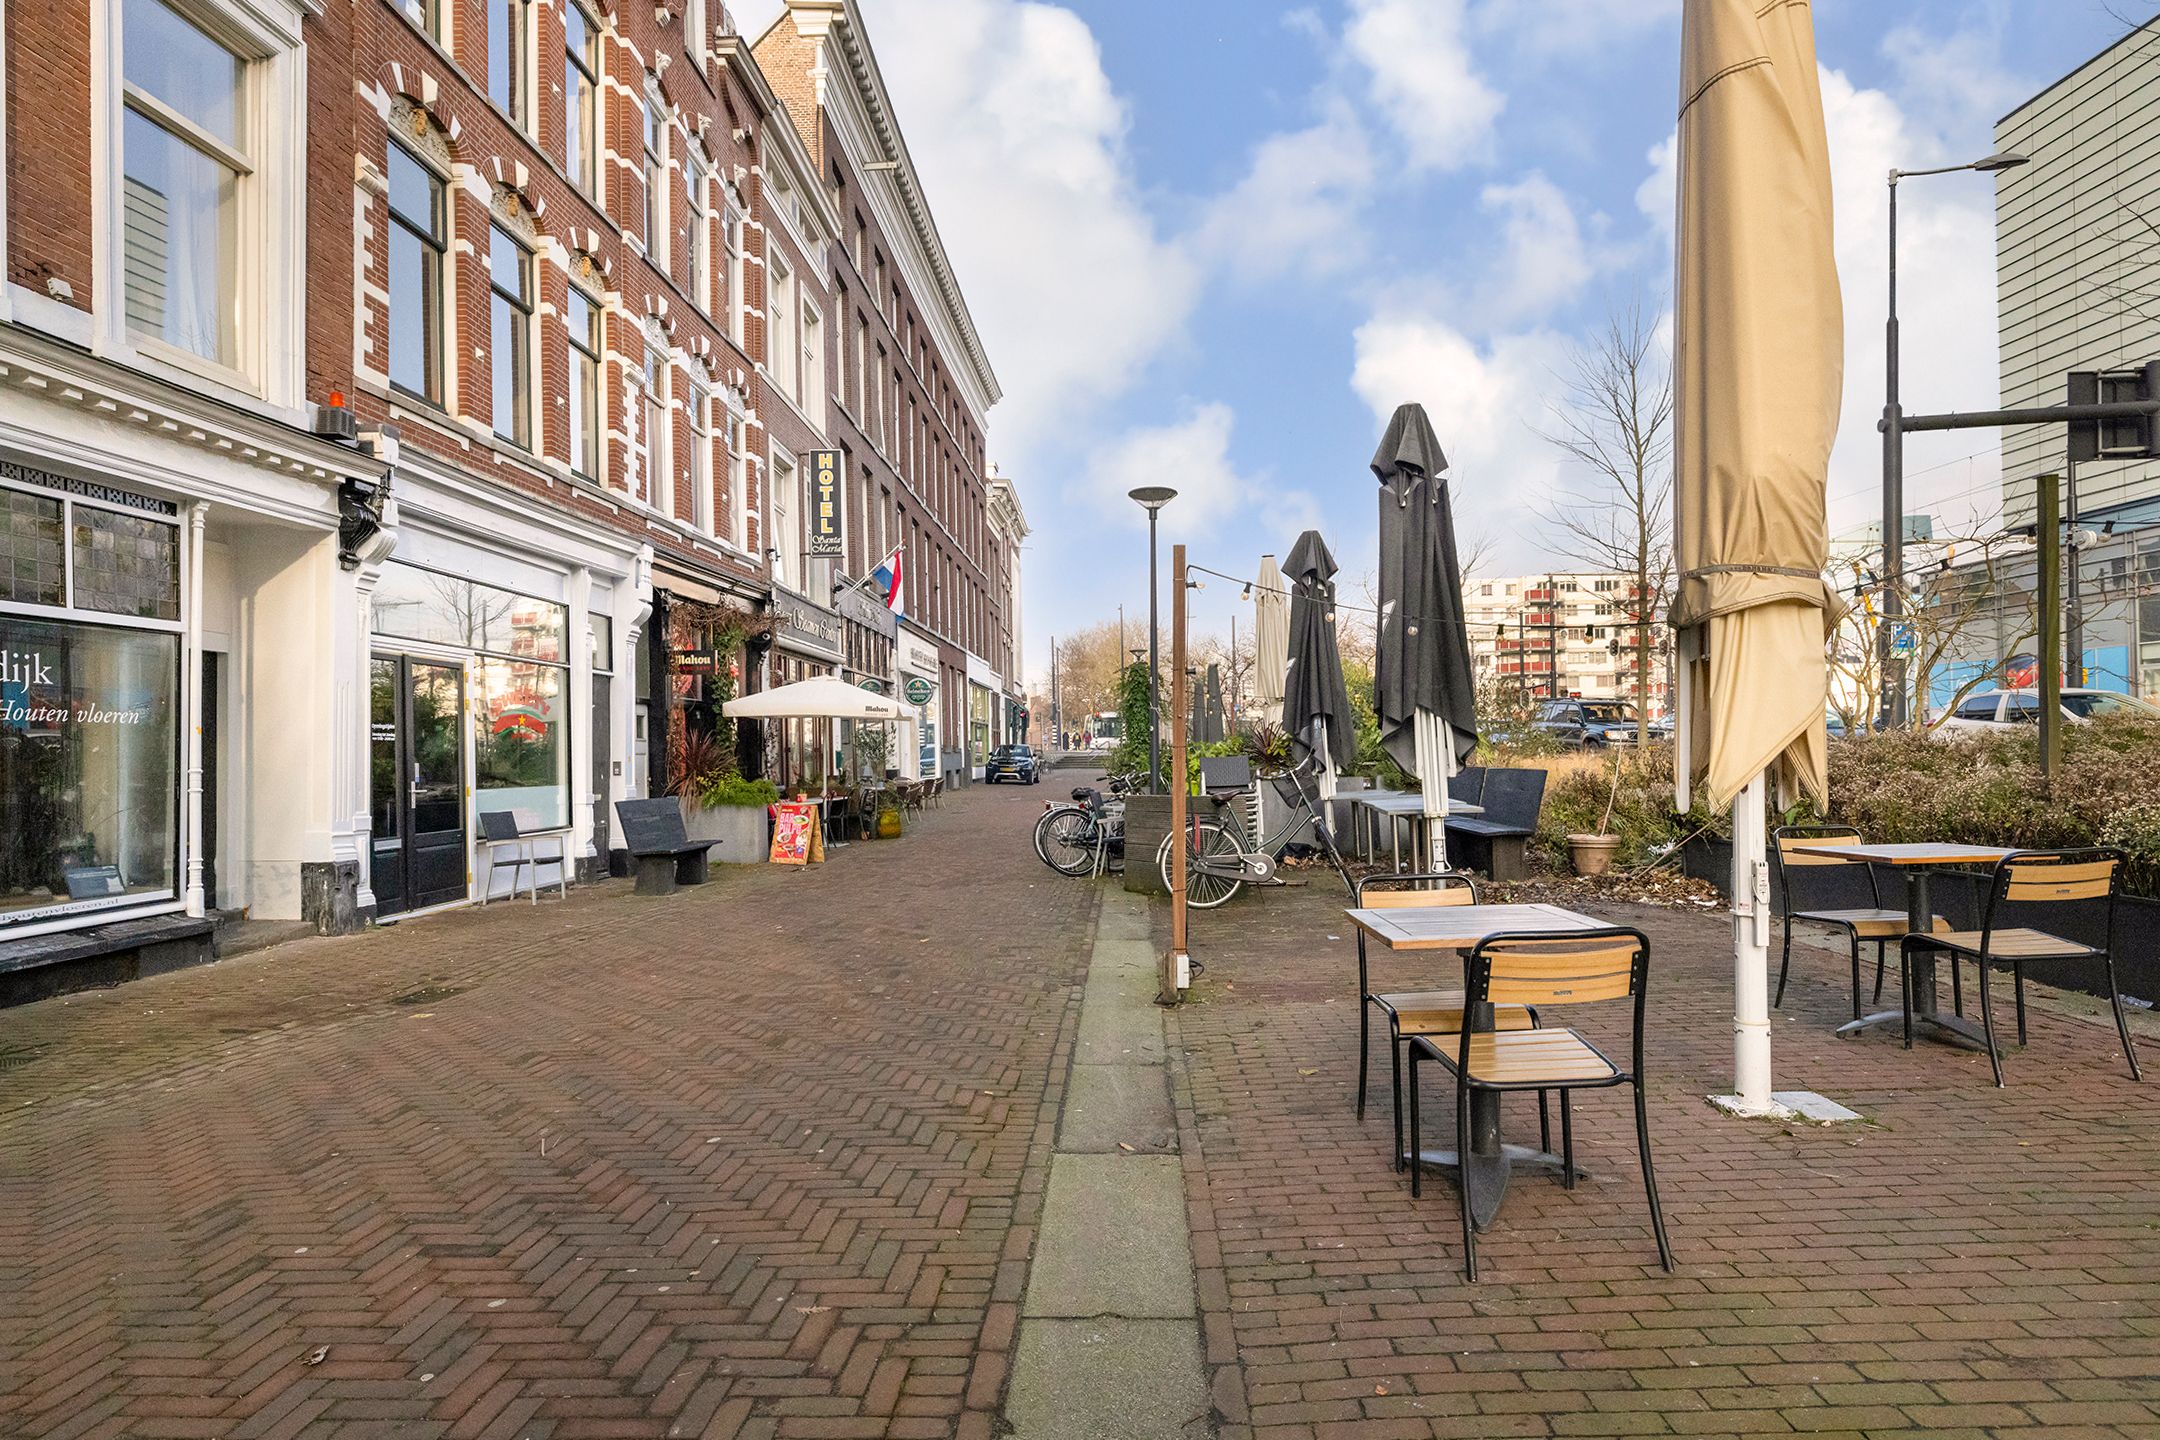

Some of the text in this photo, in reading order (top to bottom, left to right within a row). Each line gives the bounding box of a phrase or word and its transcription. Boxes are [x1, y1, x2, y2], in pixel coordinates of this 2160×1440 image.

[818, 453, 833, 533] HOTEL
[812, 535, 841, 544] Santa
[812, 545, 842, 553] Maria
[673, 654, 711, 665] Mahou
[0, 700, 139, 724] Houten vloeren
[865, 705, 888, 713] Mahou
[781, 813, 795, 823] BAR
